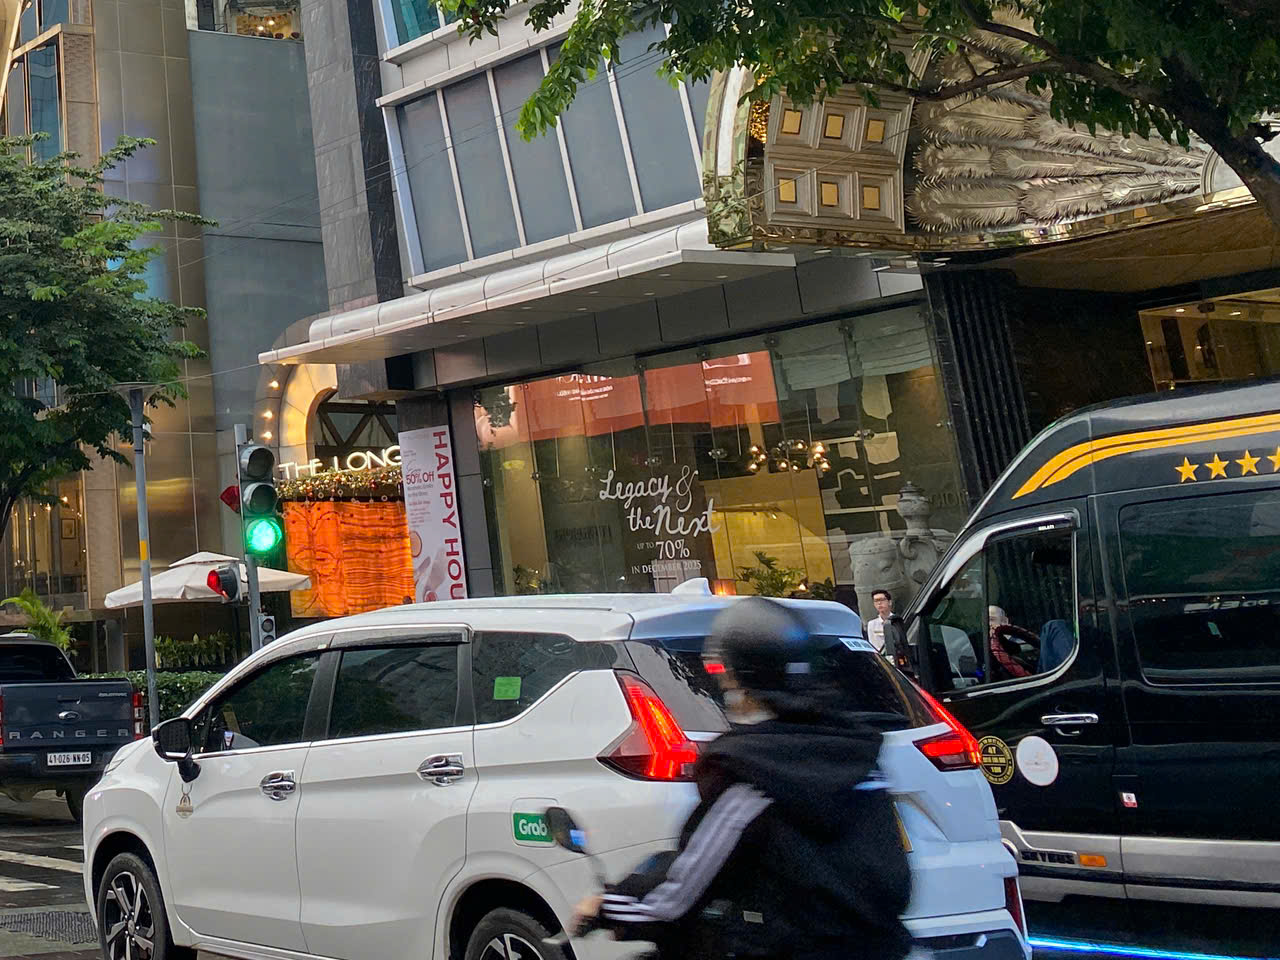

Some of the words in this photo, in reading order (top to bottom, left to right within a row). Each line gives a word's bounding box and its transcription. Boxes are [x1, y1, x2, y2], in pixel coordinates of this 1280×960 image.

[279, 458, 323, 480] THE
[333, 445, 404, 473] LONG
[406, 474, 422, 484] 50%
[422, 471, 434, 482] Off
[433, 431, 456, 529] HAPPY
[599, 469, 672, 509] Legacy
[627, 507, 655, 531] the
[653, 498, 721, 537] Next
[656, 539, 690, 560] 70%
[631, 566, 640, 574] IN
[9, 729, 128, 739] RANGER
[519, 819, 548, 836] Grab
